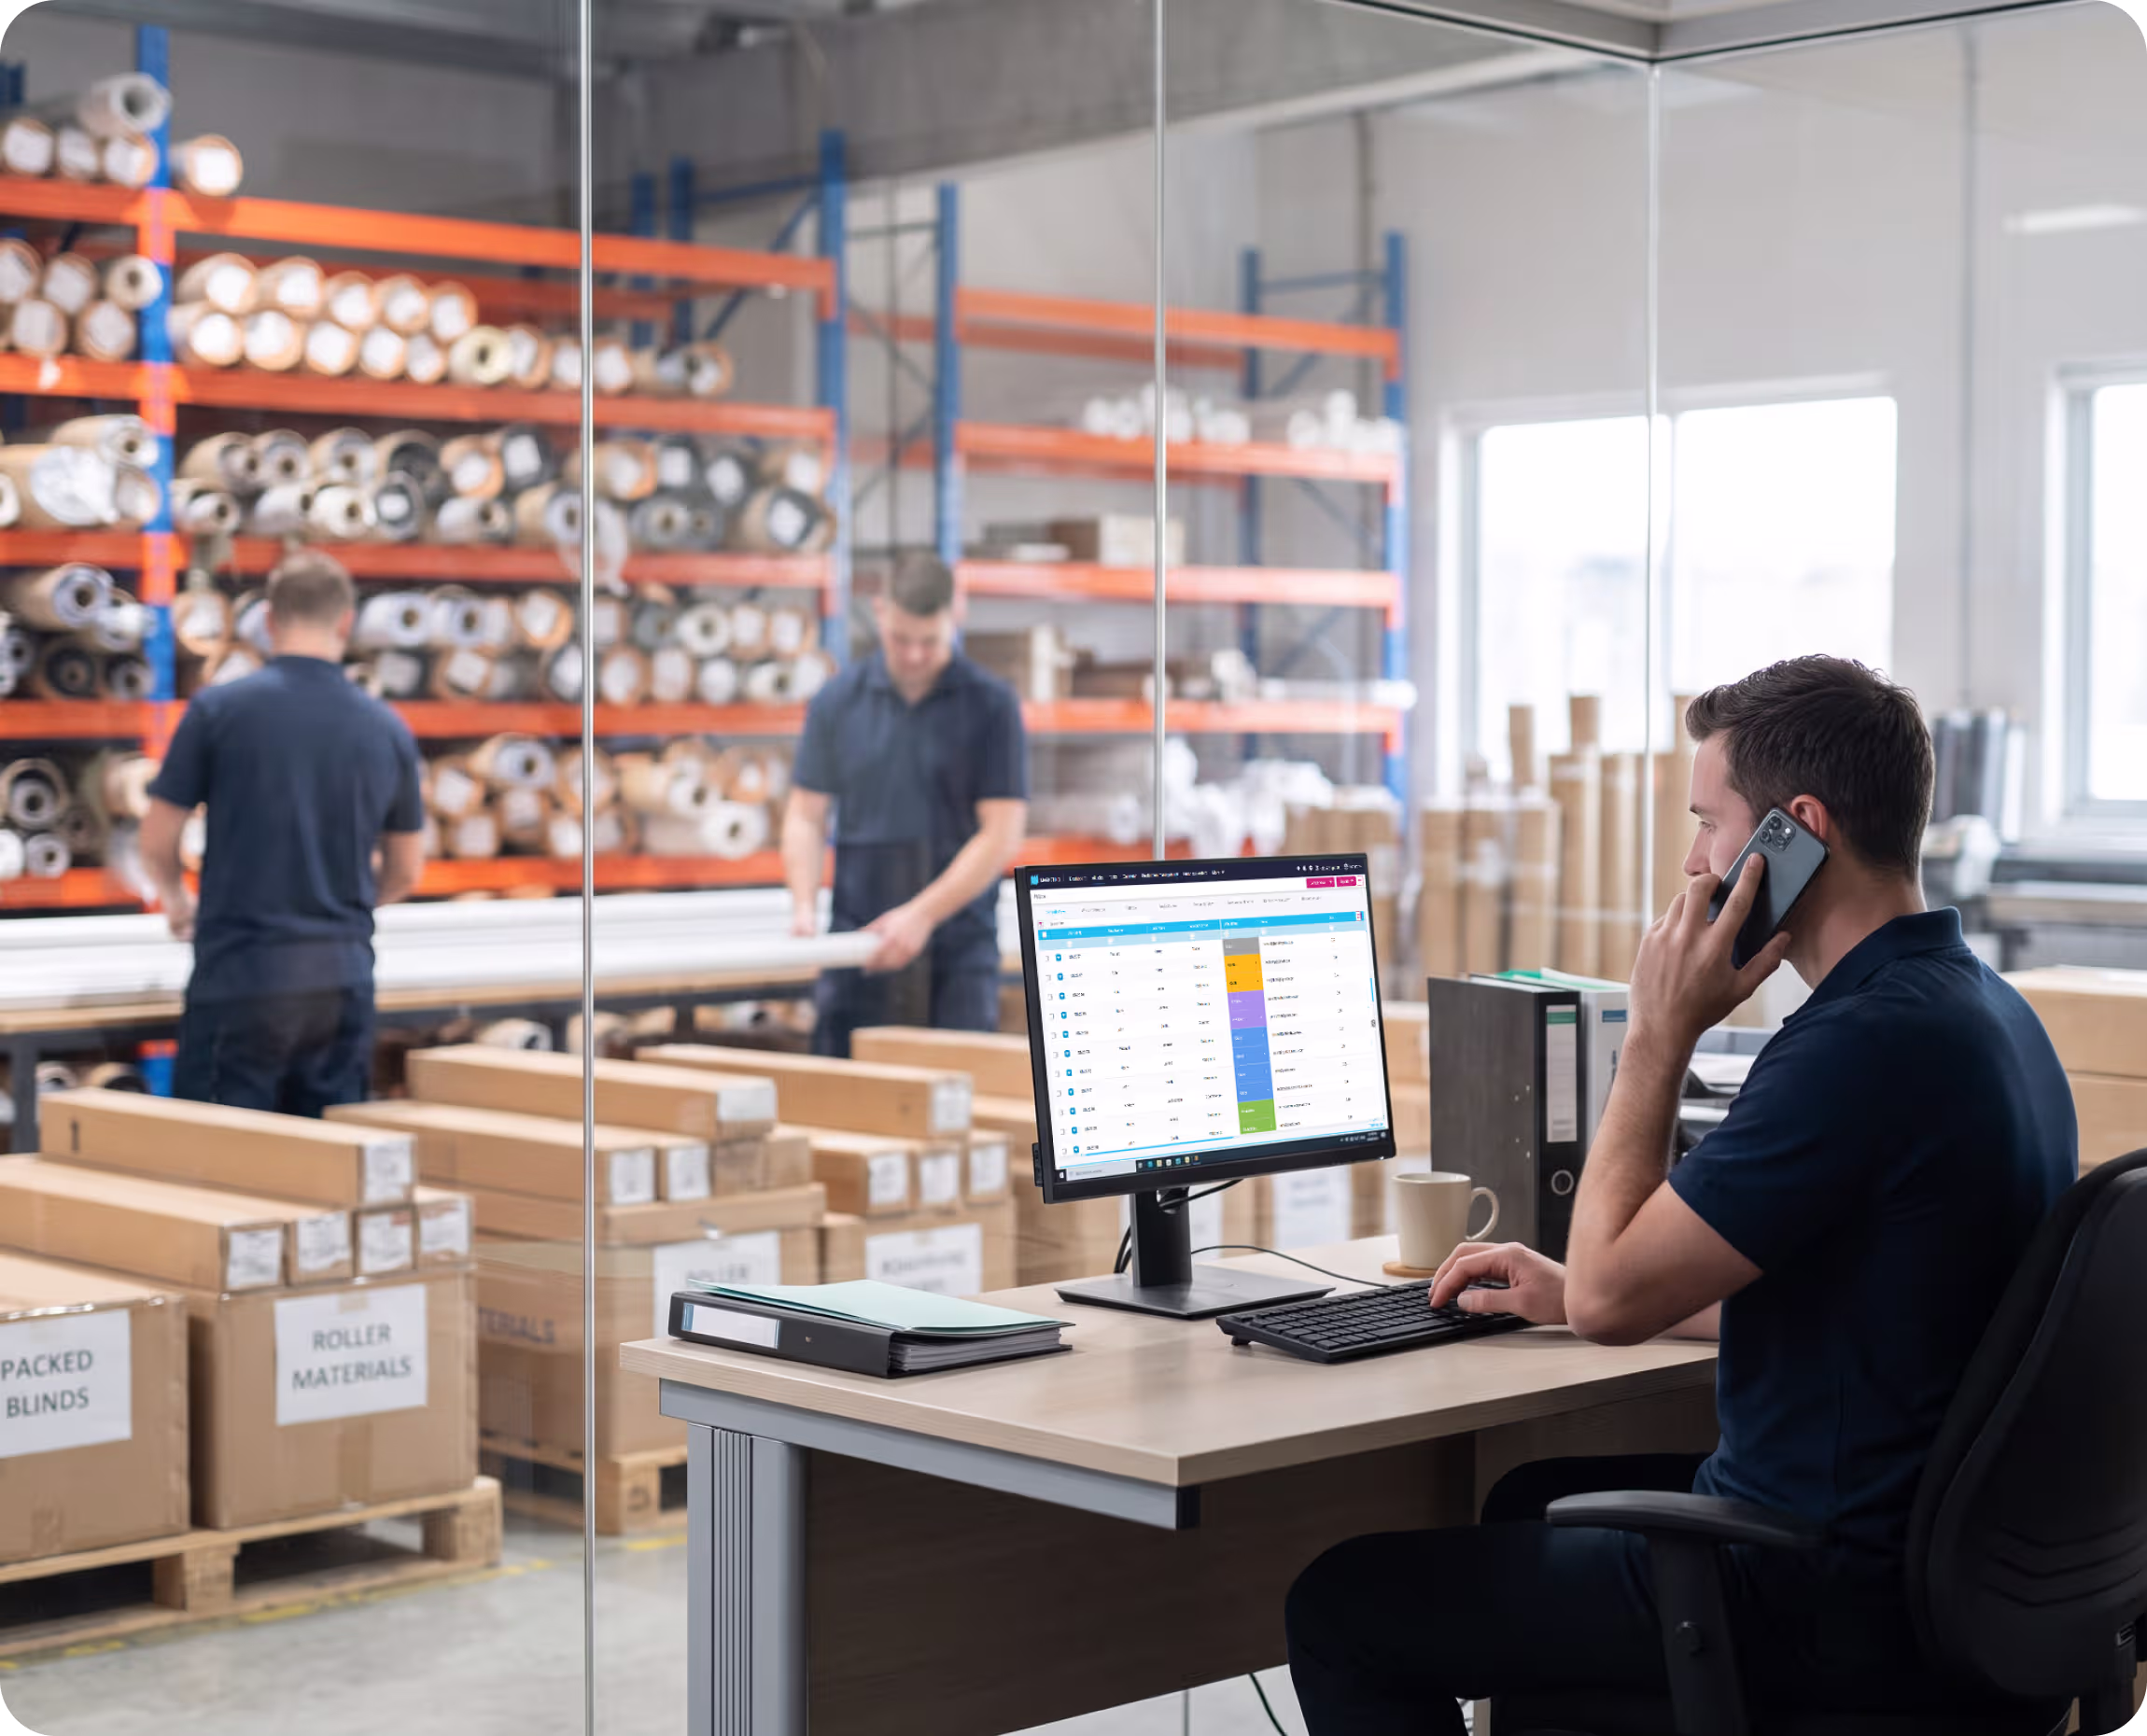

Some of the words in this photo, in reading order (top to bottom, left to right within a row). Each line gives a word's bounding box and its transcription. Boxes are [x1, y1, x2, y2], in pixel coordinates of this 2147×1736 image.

[313, 1323, 391, 1351] ROLLER
[1, 1349, 94, 1381] PACKED
[292, 1356, 412, 1390] MATERIALS
[7, 1386, 90, 1419] BLINDS
